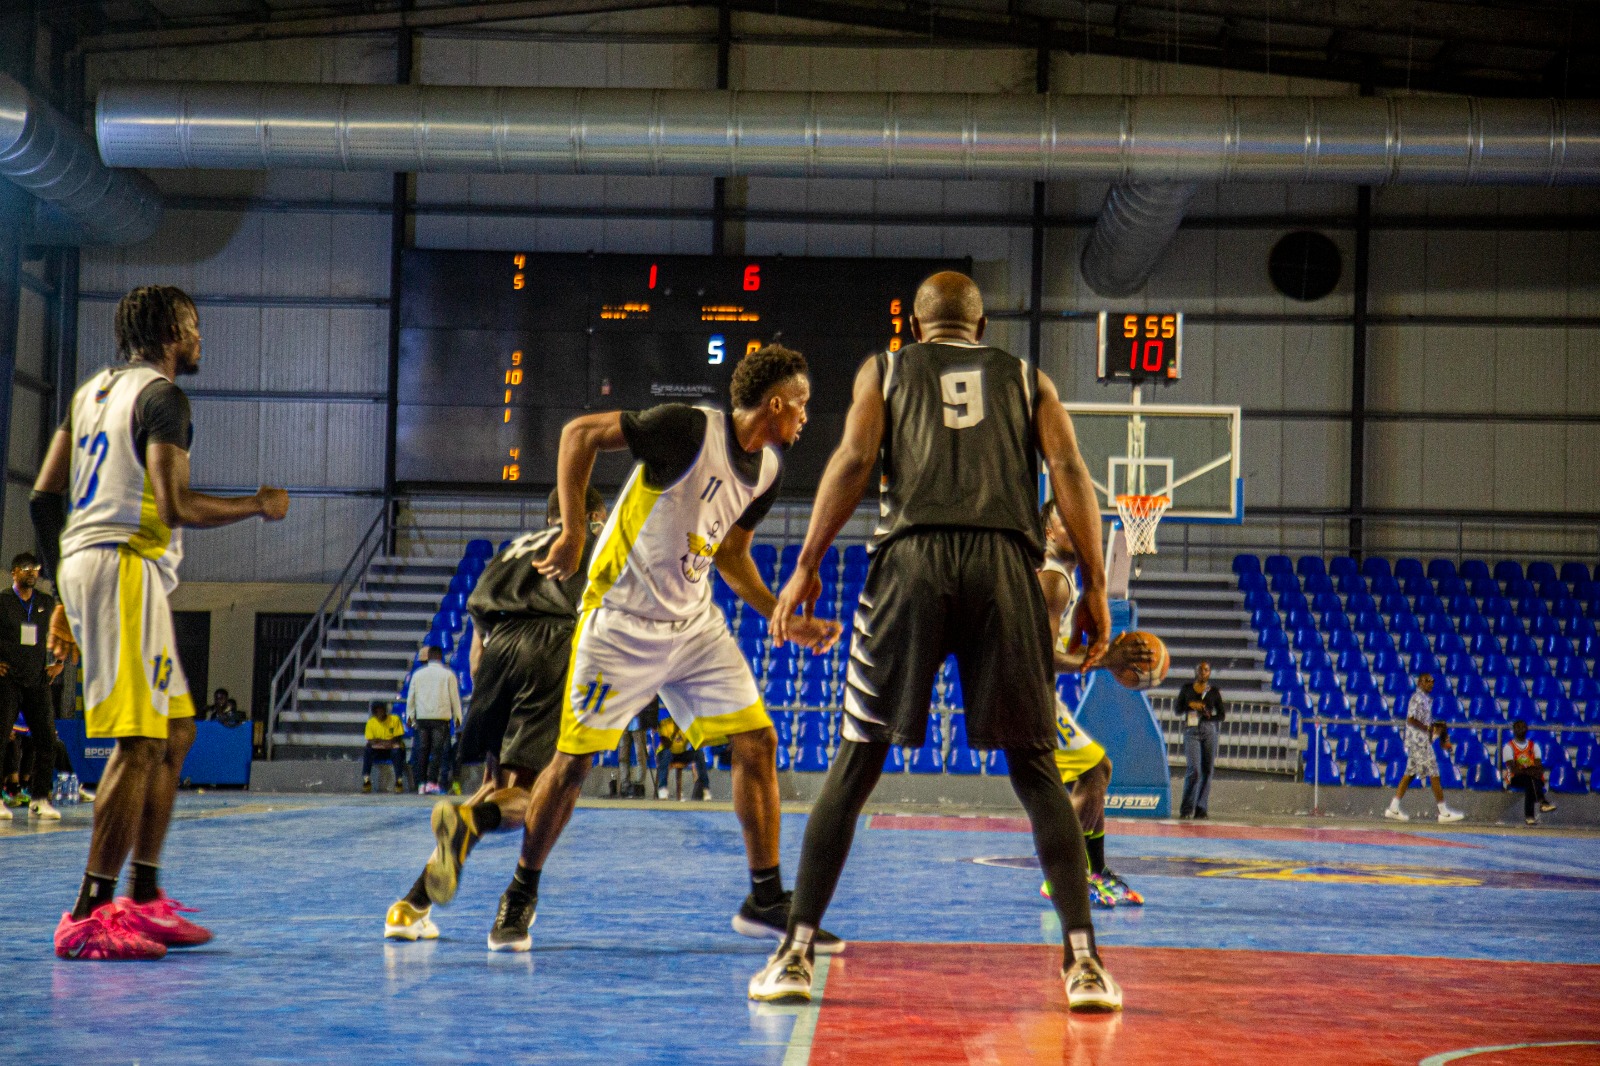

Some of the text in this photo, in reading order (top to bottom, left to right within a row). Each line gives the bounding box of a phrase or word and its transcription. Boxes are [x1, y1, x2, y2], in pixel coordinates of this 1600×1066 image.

[514, 254, 526, 269] 4
[514, 273, 525, 289] 5
[649, 264, 657, 289] 1
[743, 265, 760, 291] 6
[890, 299, 901, 314] 6
[891, 318, 902, 333] 7
[512, 351, 522, 366] 9
[707, 333, 725, 364] 5
[1130, 341, 1164, 372] 10
[505, 369, 523, 385] 10
[940, 369, 985, 430] 9
[509, 448, 520, 461] 4
[502, 464, 520, 481] 15
[700, 476, 723, 503] 11
[152, 655, 173, 692] 13
[579, 680, 612, 714] 11
